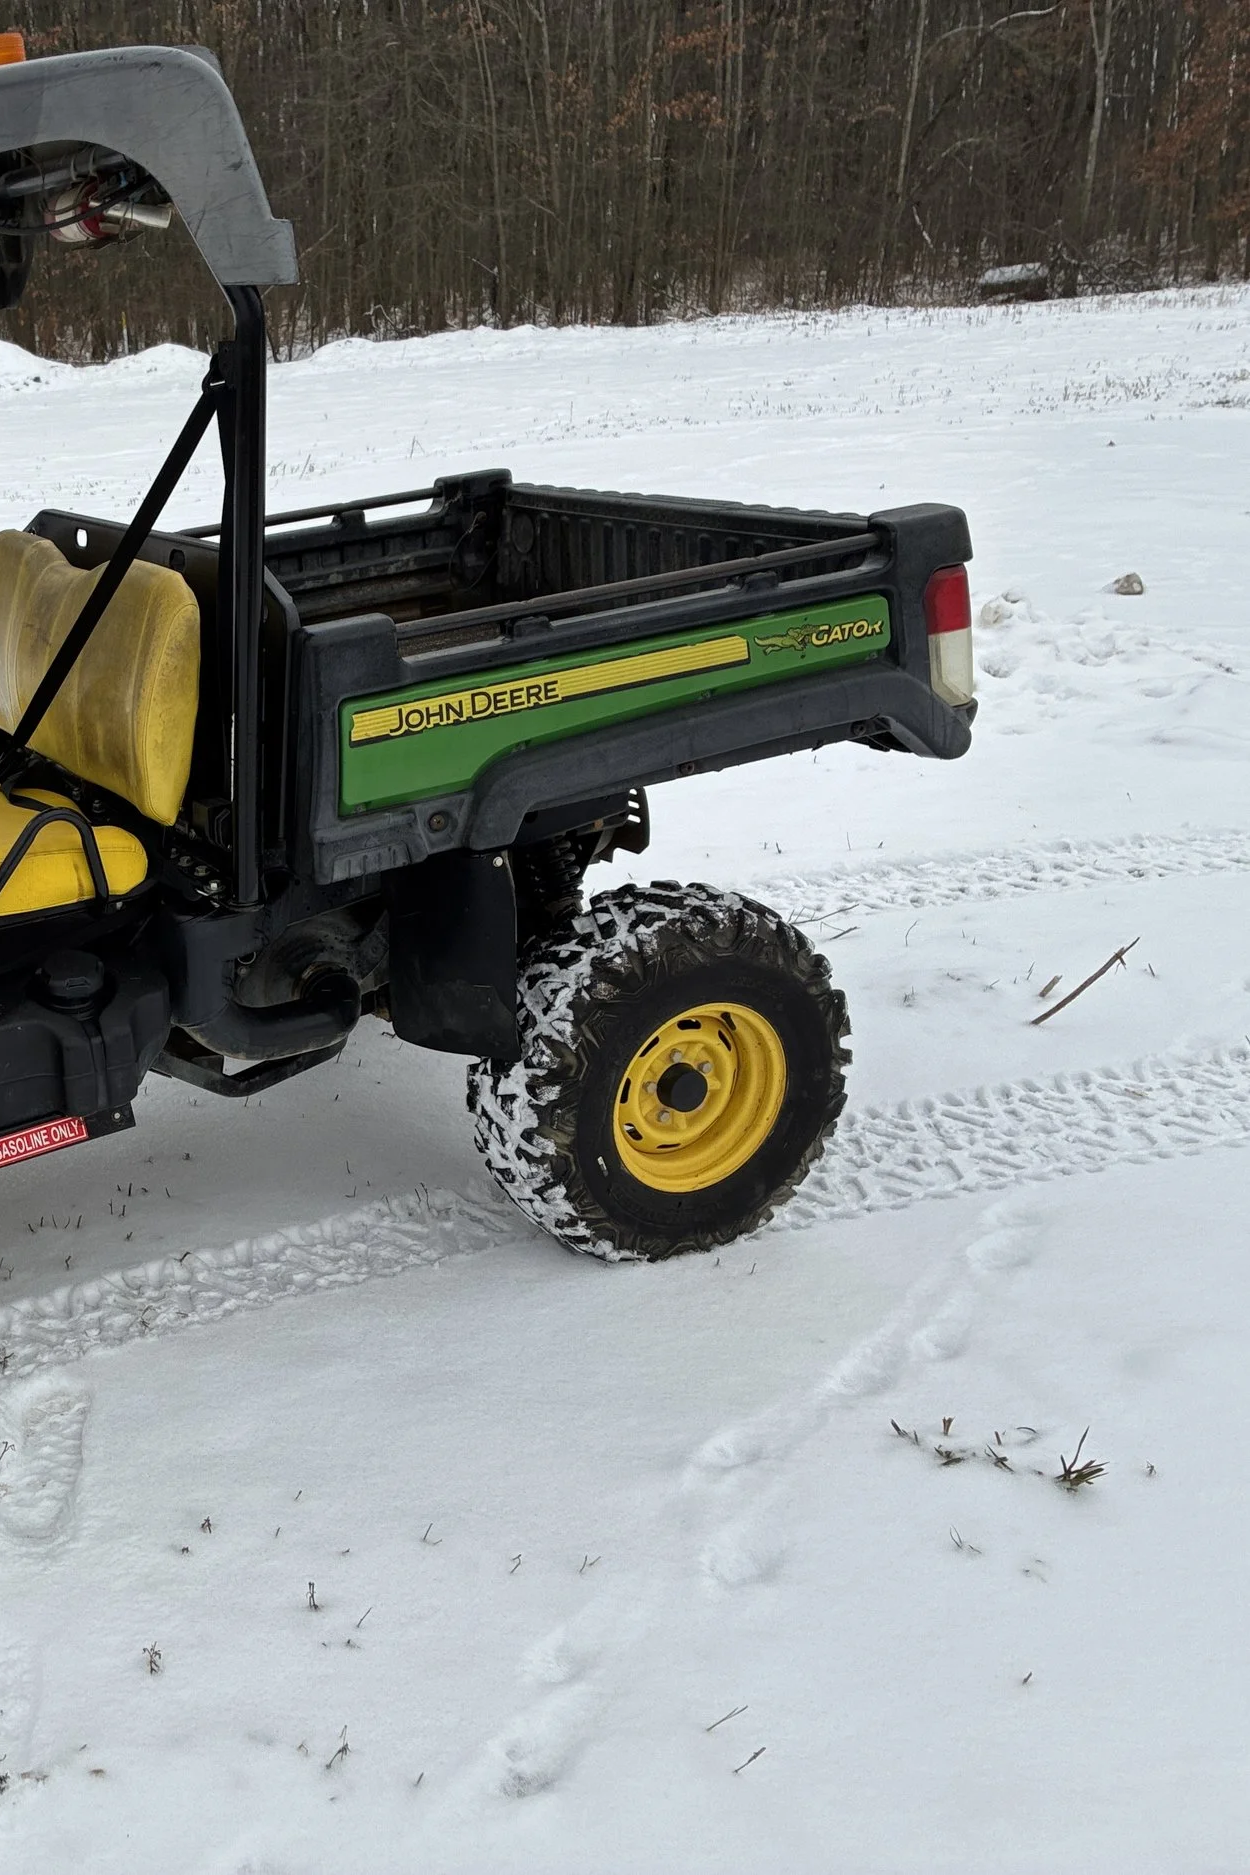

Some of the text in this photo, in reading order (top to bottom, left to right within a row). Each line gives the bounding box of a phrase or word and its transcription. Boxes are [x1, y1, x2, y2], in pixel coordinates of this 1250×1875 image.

[389, 680, 559, 733] JOHN DEERE
[50, 1119, 80, 1142] ONLY
